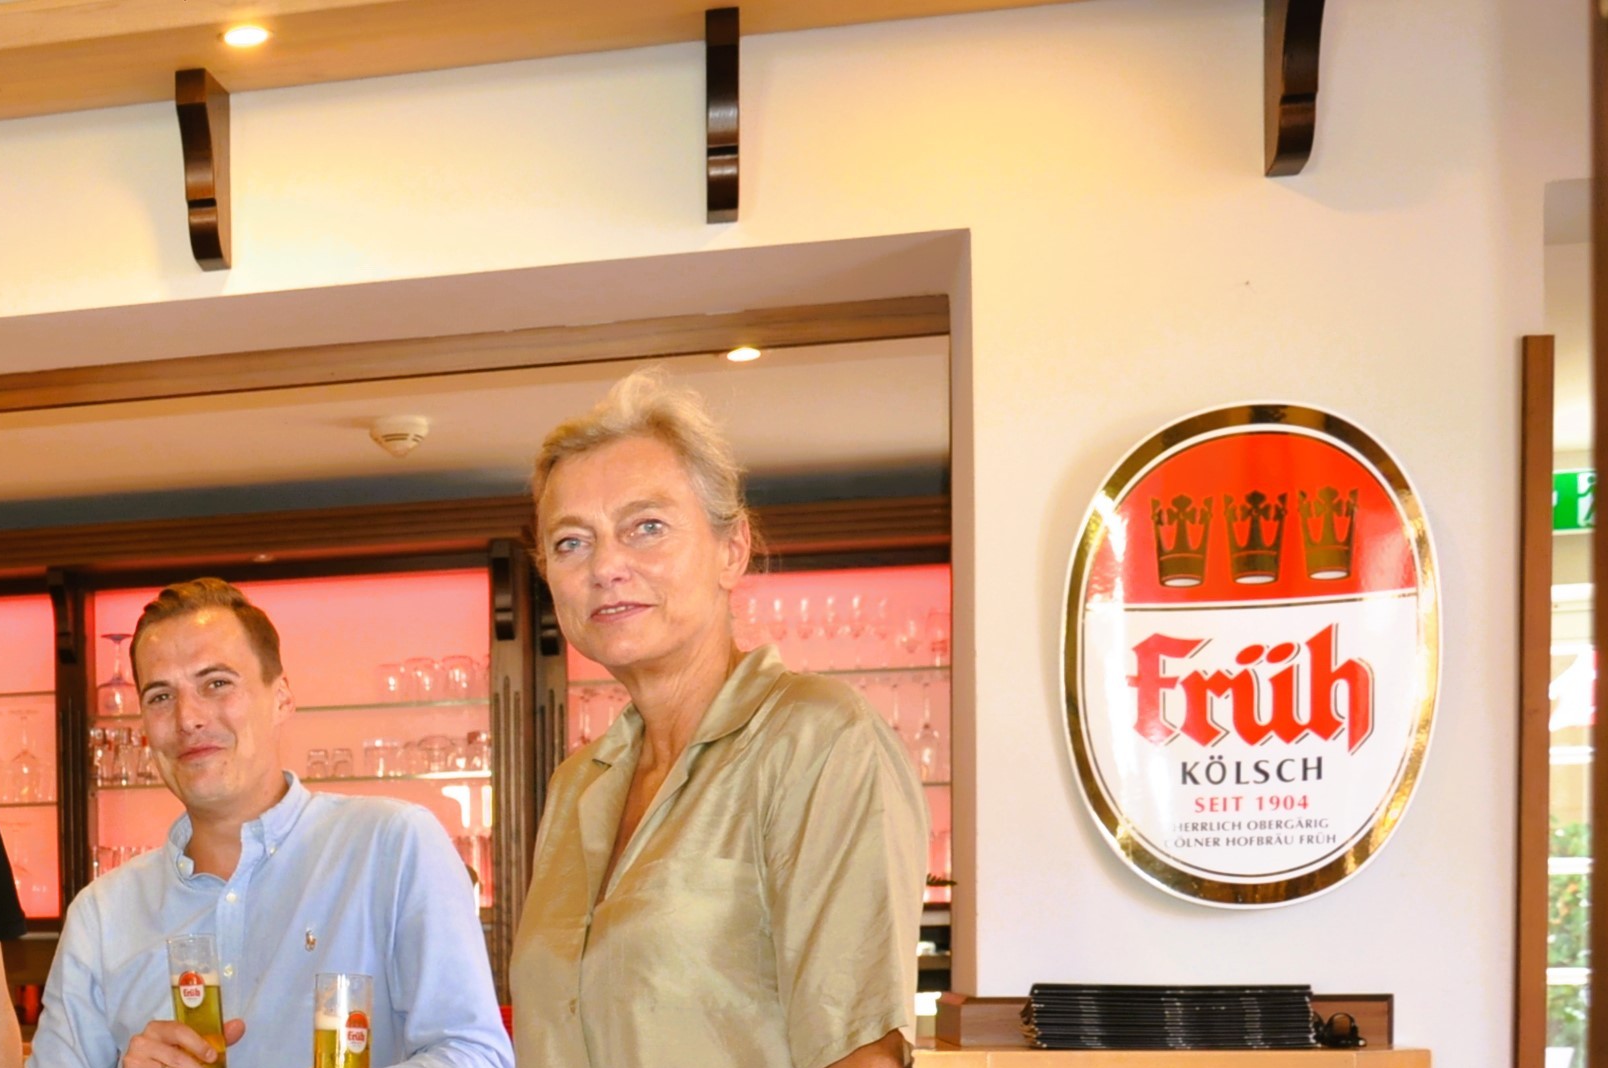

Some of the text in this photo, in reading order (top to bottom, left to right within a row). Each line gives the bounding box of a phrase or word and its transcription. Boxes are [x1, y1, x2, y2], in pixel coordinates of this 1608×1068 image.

[1126, 623, 1374, 755] Früh
[1180, 755, 1323, 785] KÖLSCH
[1194, 795, 1309, 813] SEIT 1904
[1173, 817, 1329, 833] HERRLICH OBERGÄRIG
[1225, 833, 1294, 846] HOFBRÄU
[1299, 834, 1337, 844] FRÜH
